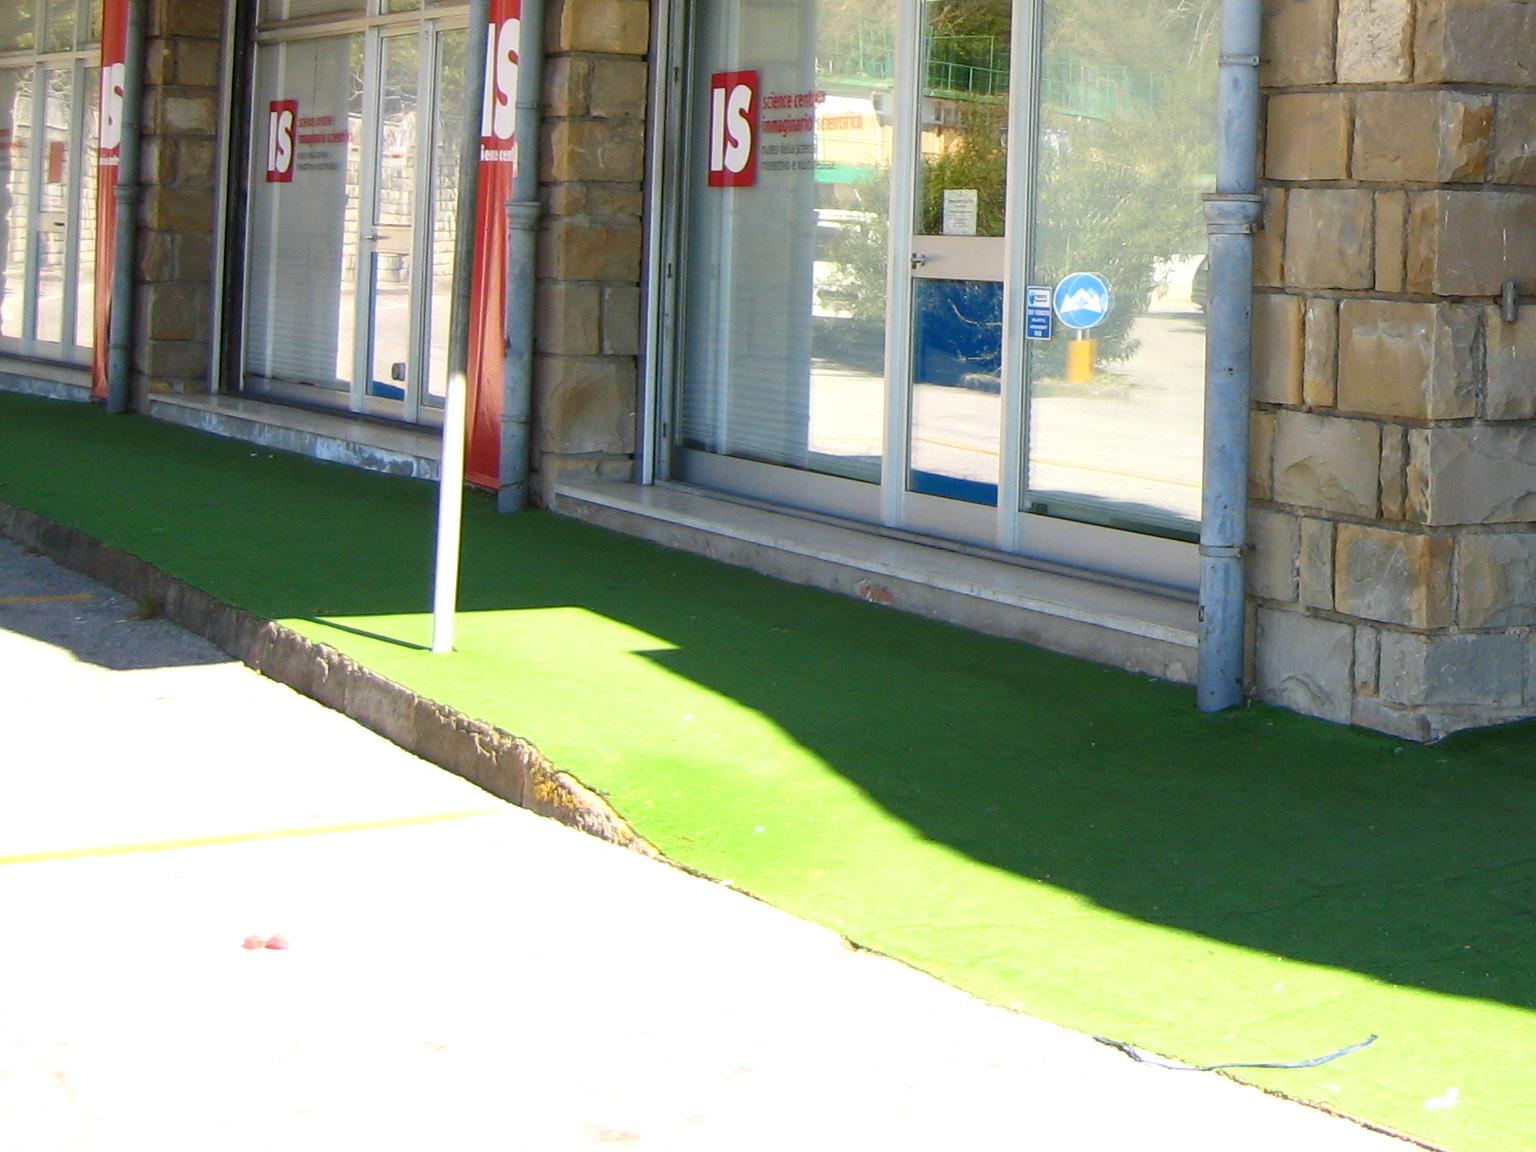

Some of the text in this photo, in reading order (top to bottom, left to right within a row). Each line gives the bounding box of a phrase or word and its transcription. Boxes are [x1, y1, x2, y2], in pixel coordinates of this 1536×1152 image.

[481, 18, 520, 140] IS
[268, 111, 294, 173] IS
[710, 84, 752, 173] IS
